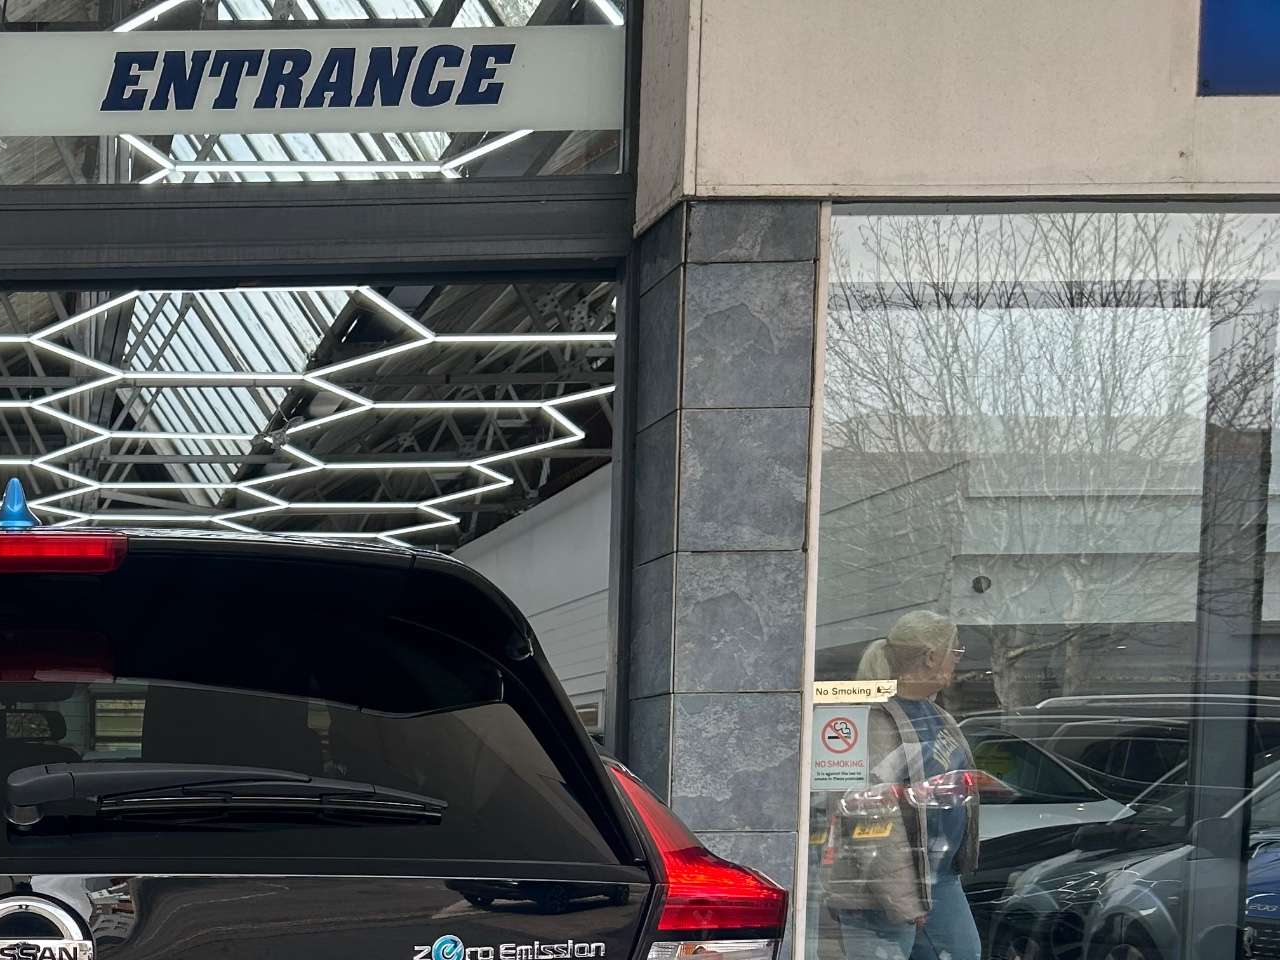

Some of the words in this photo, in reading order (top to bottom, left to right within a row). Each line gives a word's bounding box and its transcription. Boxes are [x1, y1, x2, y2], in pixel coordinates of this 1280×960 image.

[99, 43, 517, 112] ENTRANCE
[815, 687, 829, 696] No
[831, 686, 872, 697] Smoking
[815, 760, 826, 768] NO
[499, 939, 606, 960] Emission
